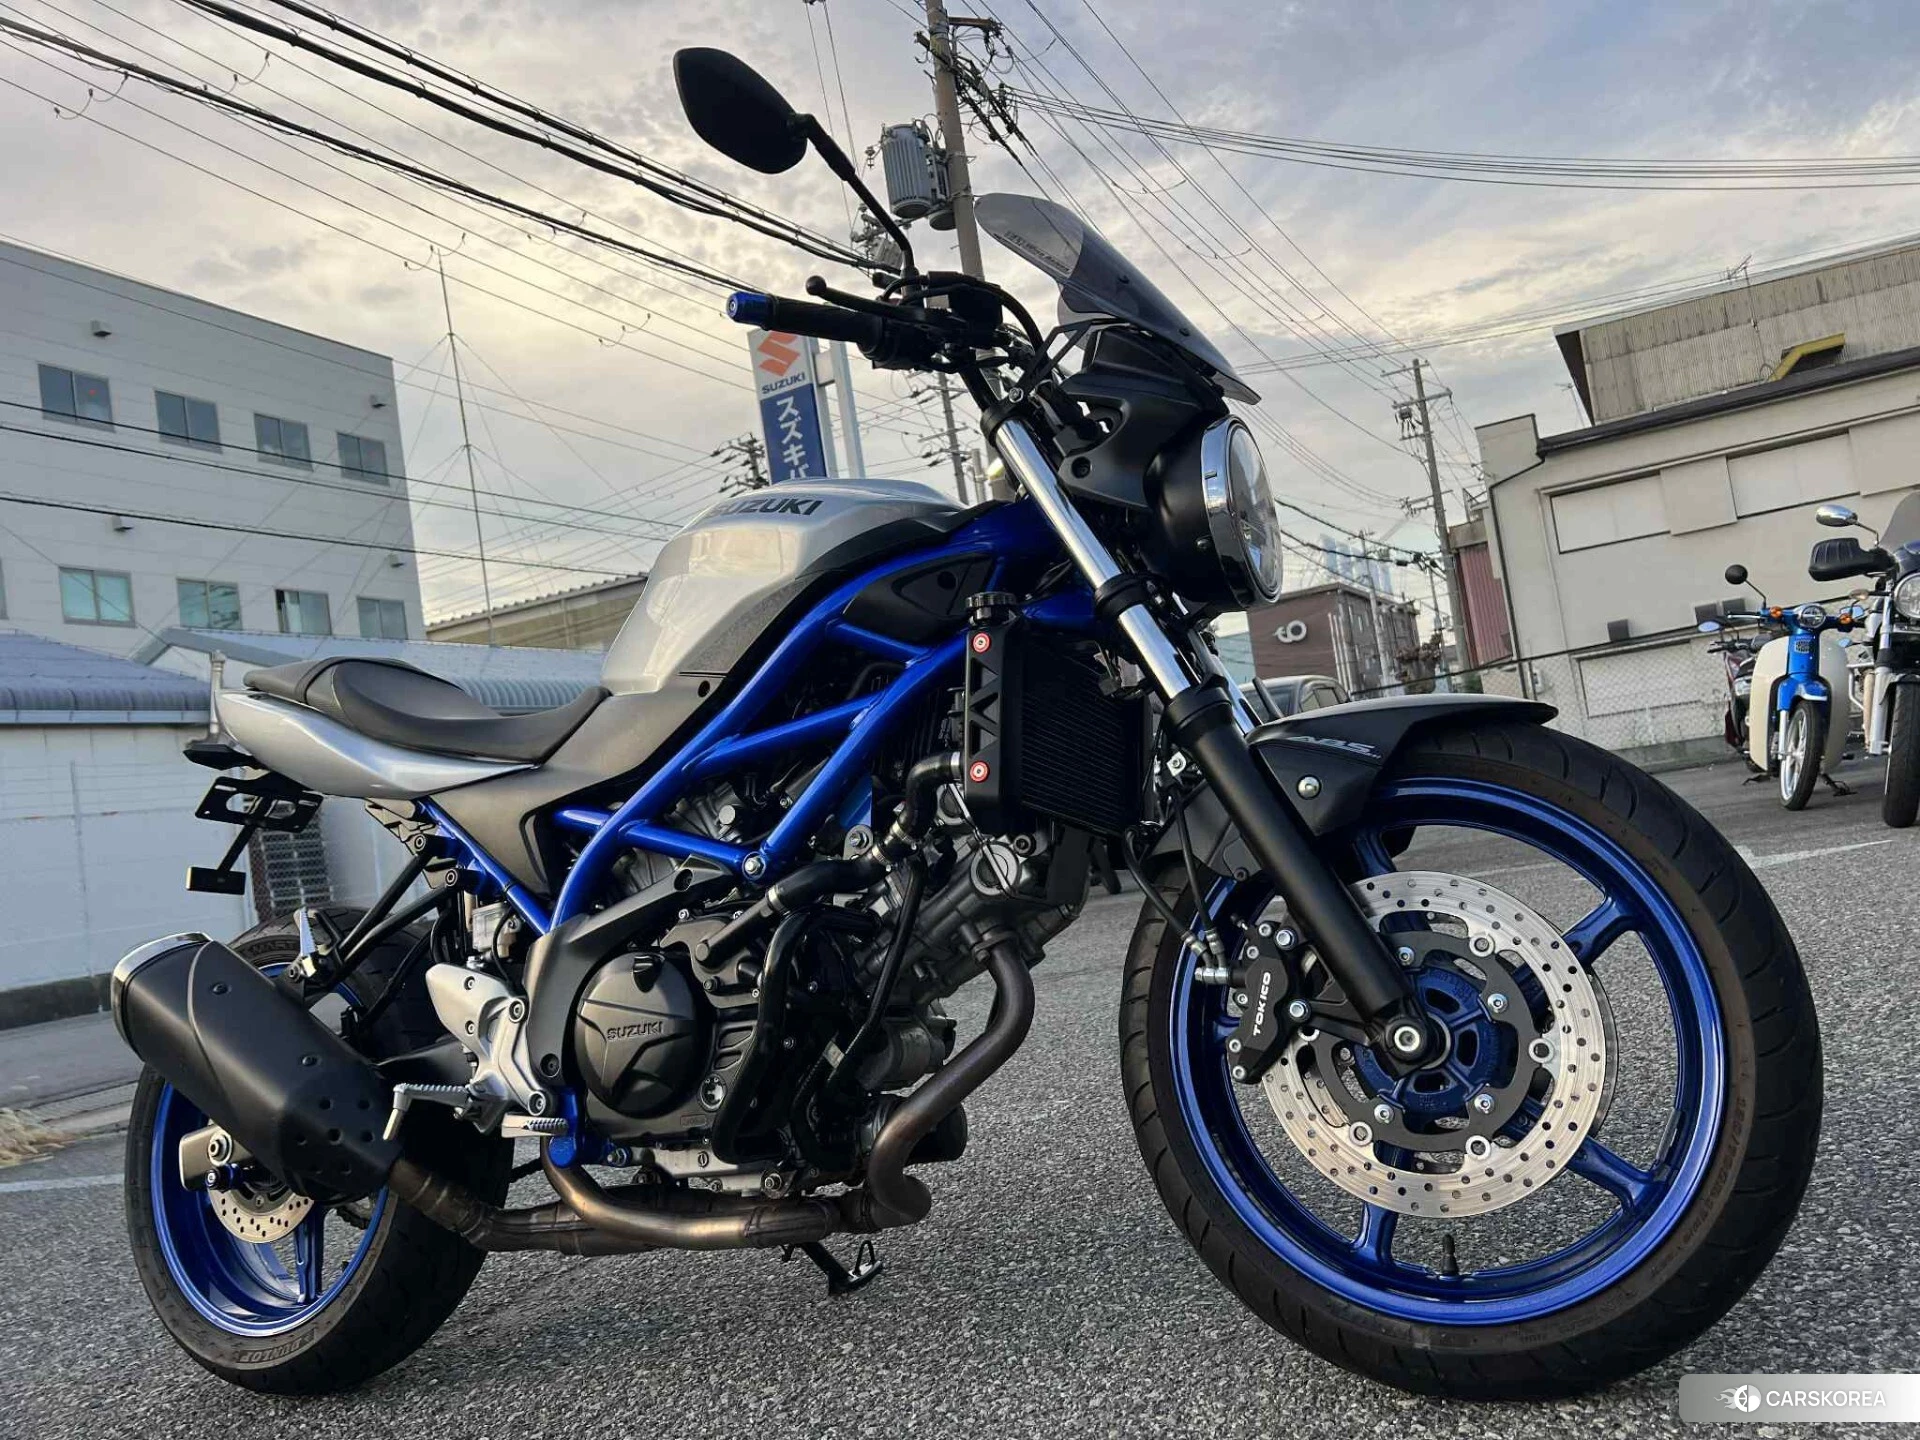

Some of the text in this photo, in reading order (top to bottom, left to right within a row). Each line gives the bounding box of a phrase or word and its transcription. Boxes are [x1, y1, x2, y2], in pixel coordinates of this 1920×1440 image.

[762, 372, 805, 394] SUZUKI
[703, 499, 824, 516] SUZUKI
[1253, 972, 1271, 1036] TOKICO
[606, 1021, 663, 1040] SUZUKI
[239, 1337, 302, 1363] DUNLOP
